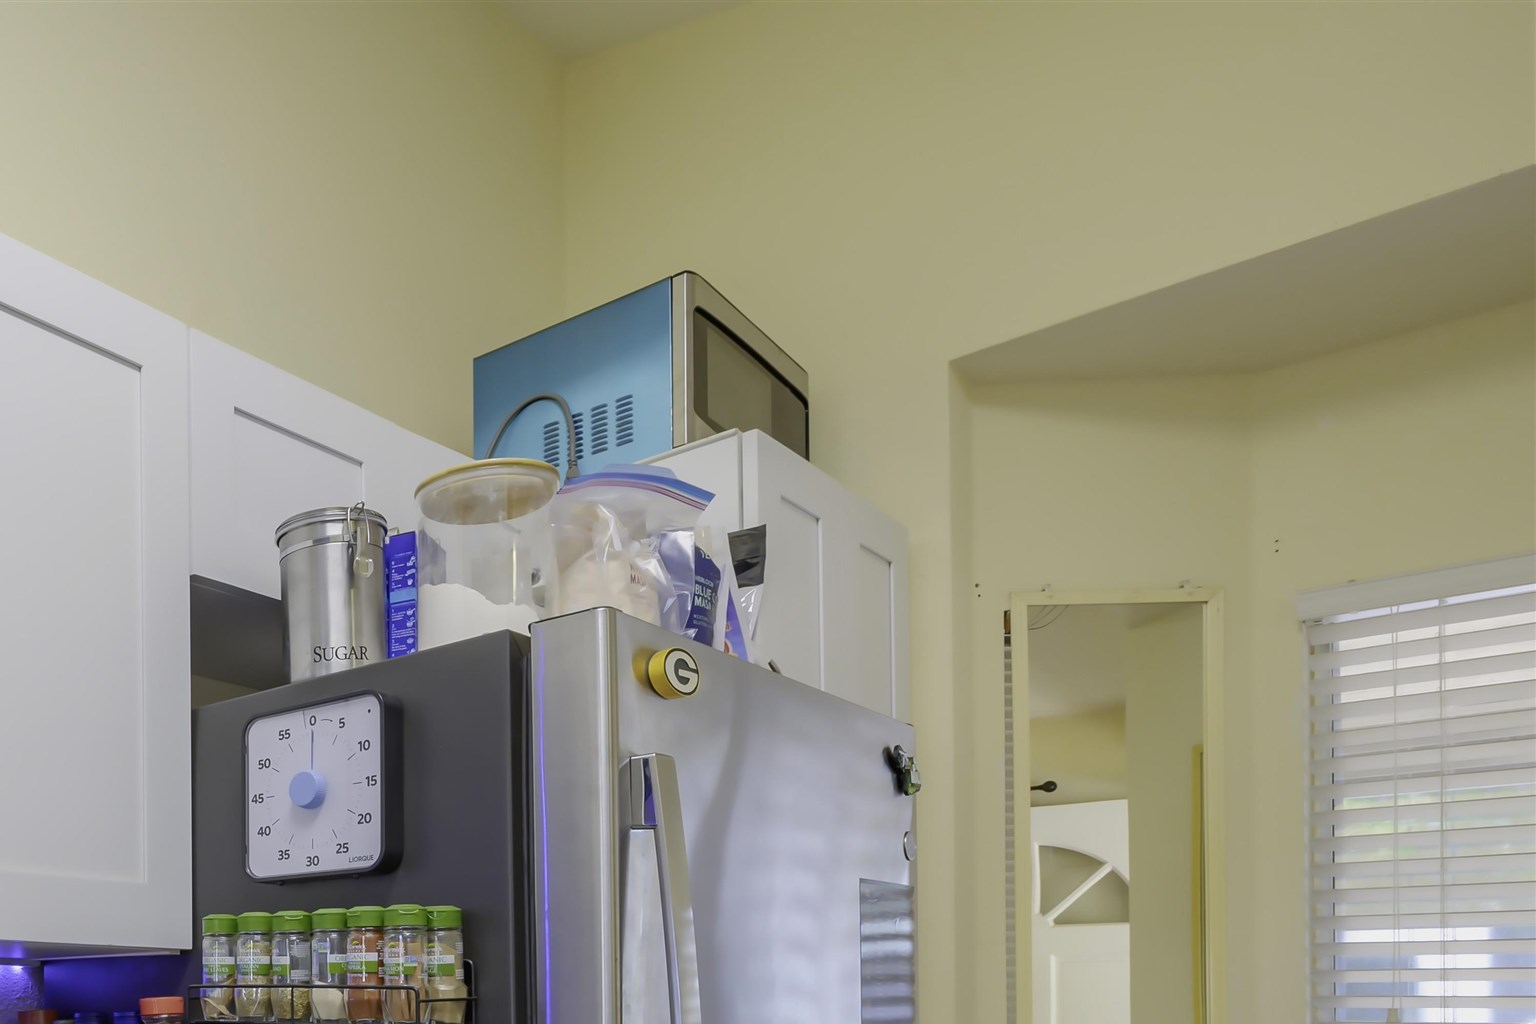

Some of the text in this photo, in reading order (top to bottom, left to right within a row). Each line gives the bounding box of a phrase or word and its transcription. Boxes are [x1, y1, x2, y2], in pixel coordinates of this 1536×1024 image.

[695, 584, 712, 600] BLUE
[313, 646, 369, 663] SUGAR
[310, 715, 316, 726] 0
[339, 718, 345, 728] 5
[278, 729, 291, 740] 55
[357, 740, 370, 751] 10
[258, 758, 271, 770] 50
[365, 775, 377, 787] 15
[251, 793, 264, 805] 45
[357, 813, 372, 824] 20
[257, 825, 271, 836] 40
[336, 843, 349, 854] 25
[278, 850, 290, 860] 35
[349, 854, 374, 863] LIORQUE
[305, 856, 319, 867] 30
